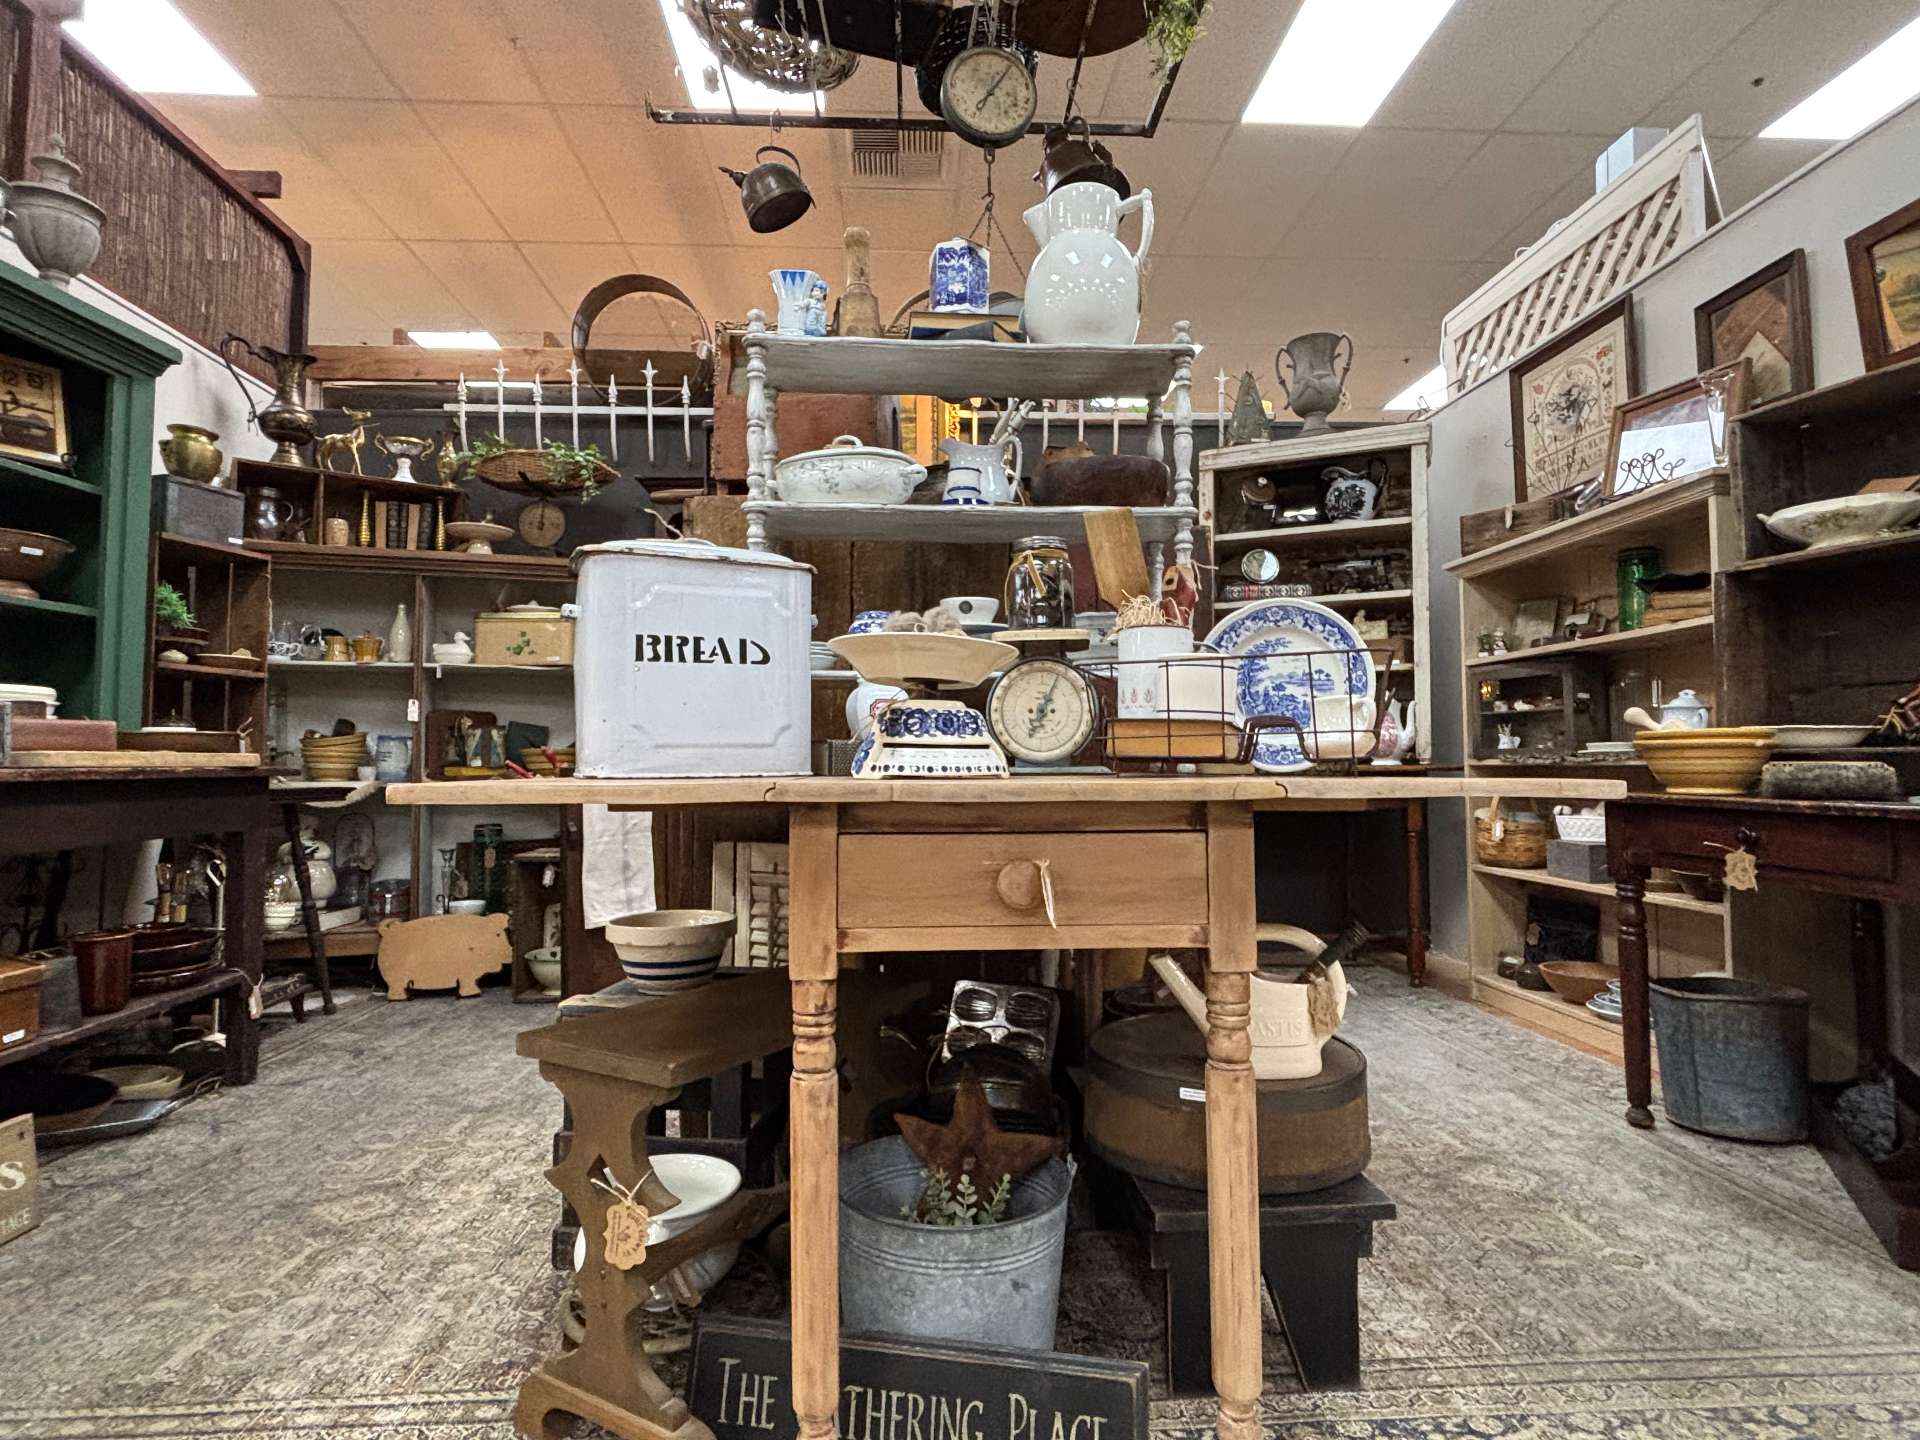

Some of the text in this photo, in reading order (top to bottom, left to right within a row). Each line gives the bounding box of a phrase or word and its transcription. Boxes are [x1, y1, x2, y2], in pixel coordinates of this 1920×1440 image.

[634, 634, 771, 665] BREAD
[1251, 1020, 1302, 1037] ASTIS
[717, 1357, 779, 1430] THE
[834, 1385, 985, 1440] THERING
